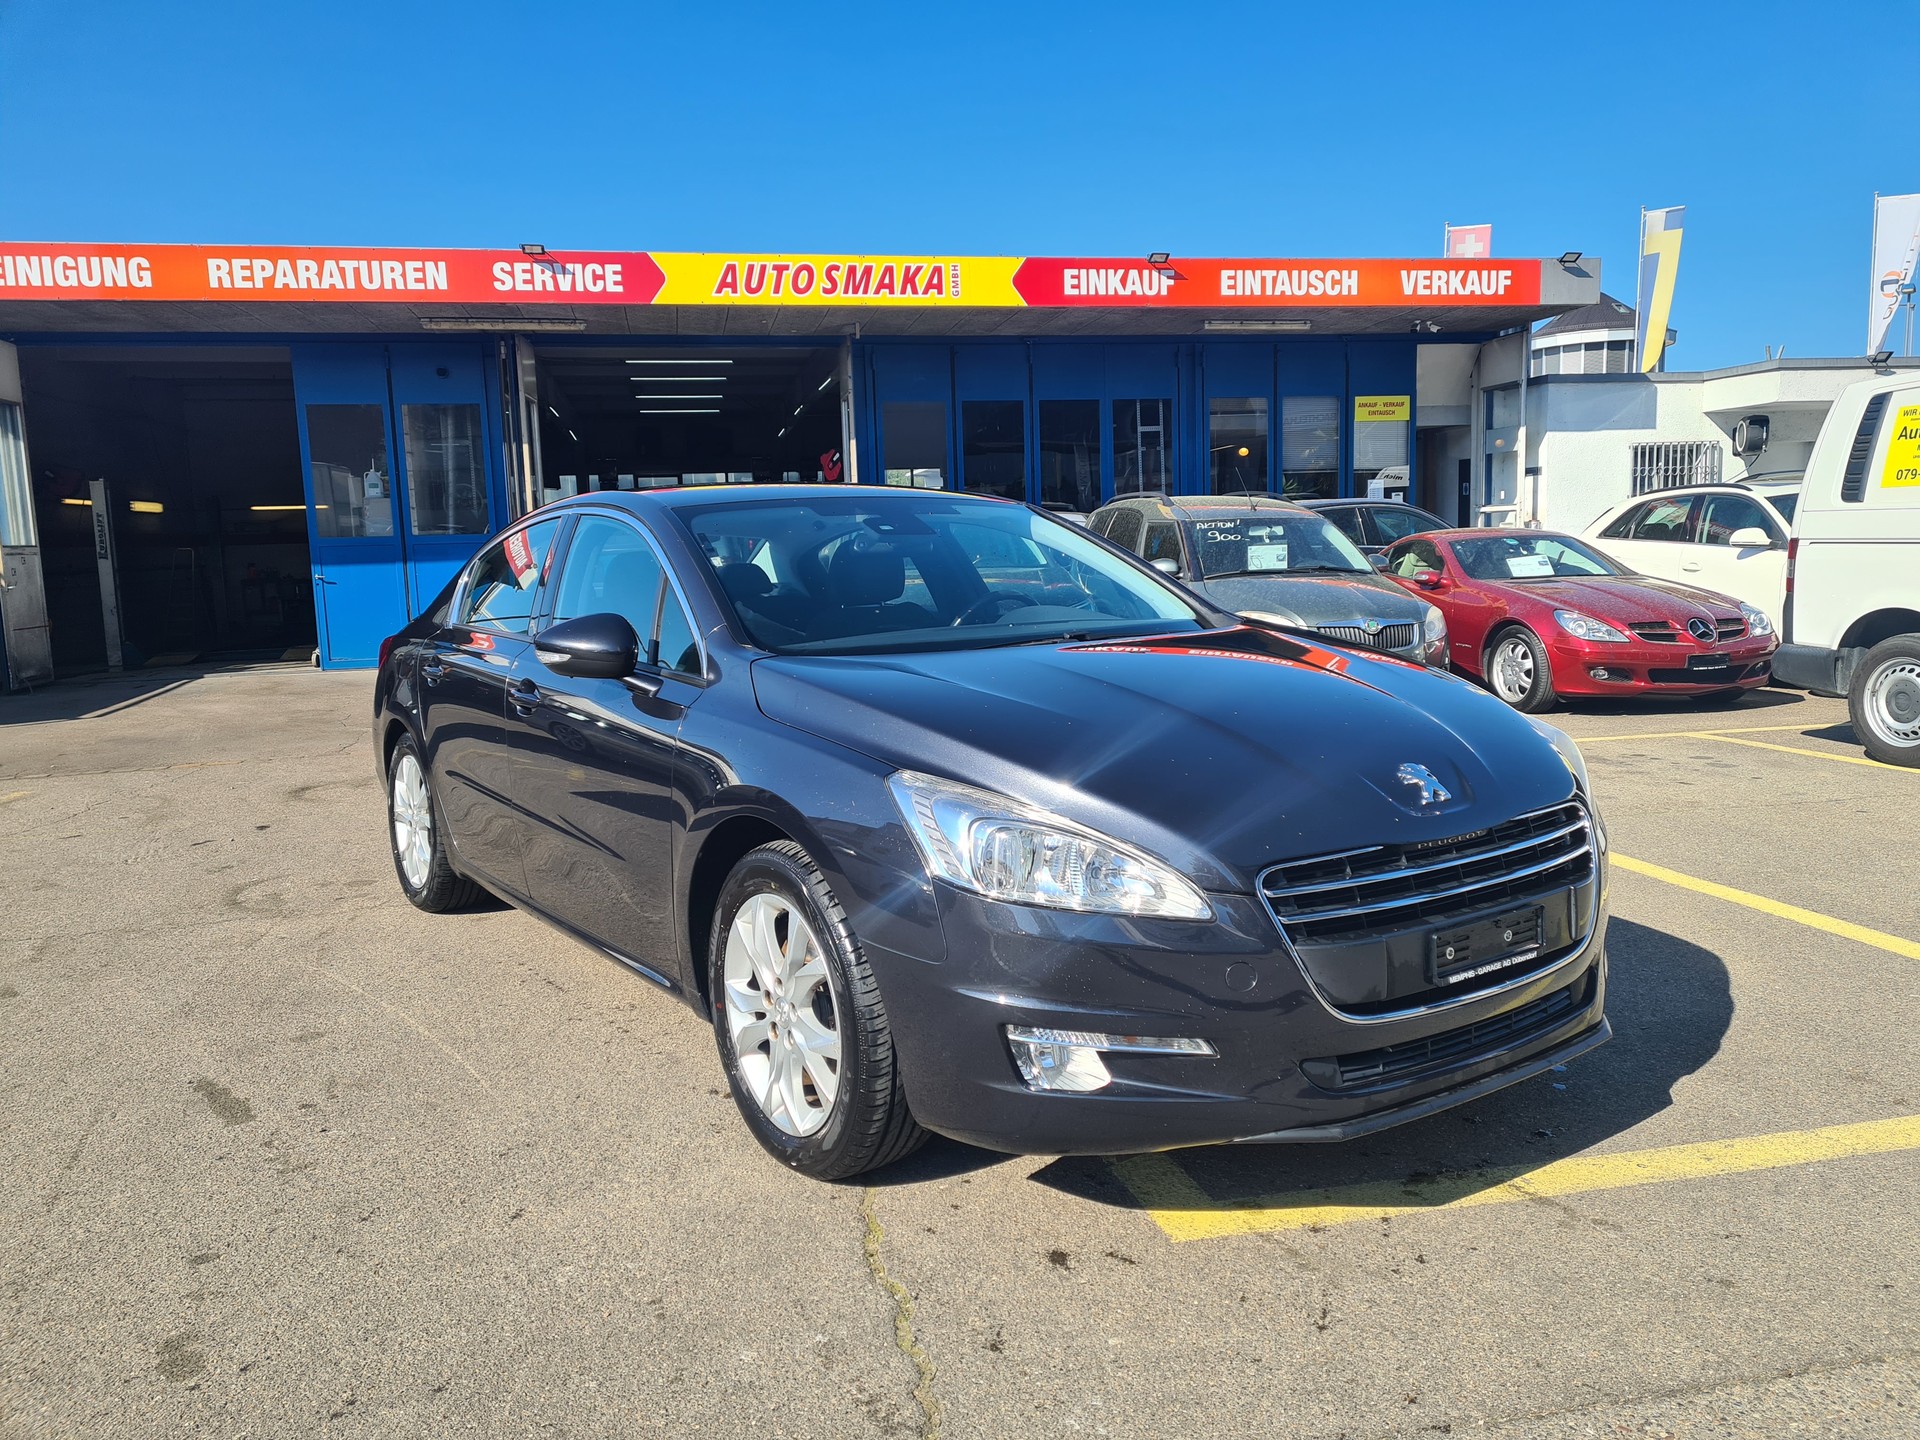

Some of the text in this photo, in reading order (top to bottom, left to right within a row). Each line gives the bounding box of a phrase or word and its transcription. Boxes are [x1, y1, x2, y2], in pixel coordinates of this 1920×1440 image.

[206, 258, 449, 290] REPARATUREN
[492, 261, 624, 293] SERVICE
[713, 262, 945, 296] AUTO SMAKA
[950, 263, 960, 298] GMBH
[1063, 268, 1175, 296] EINKAUF
[1220, 269, 1359, 296] EINTAUSCH
[1400, 269, 1512, 296] VERKAUF
[1903, 408, 1918, 417] WIR
[1417, 829, 1488, 849] PEUGEOT
[1502, 959, 1511, 968] AG
[1511, 950, 1537, 965] Dübendorf
